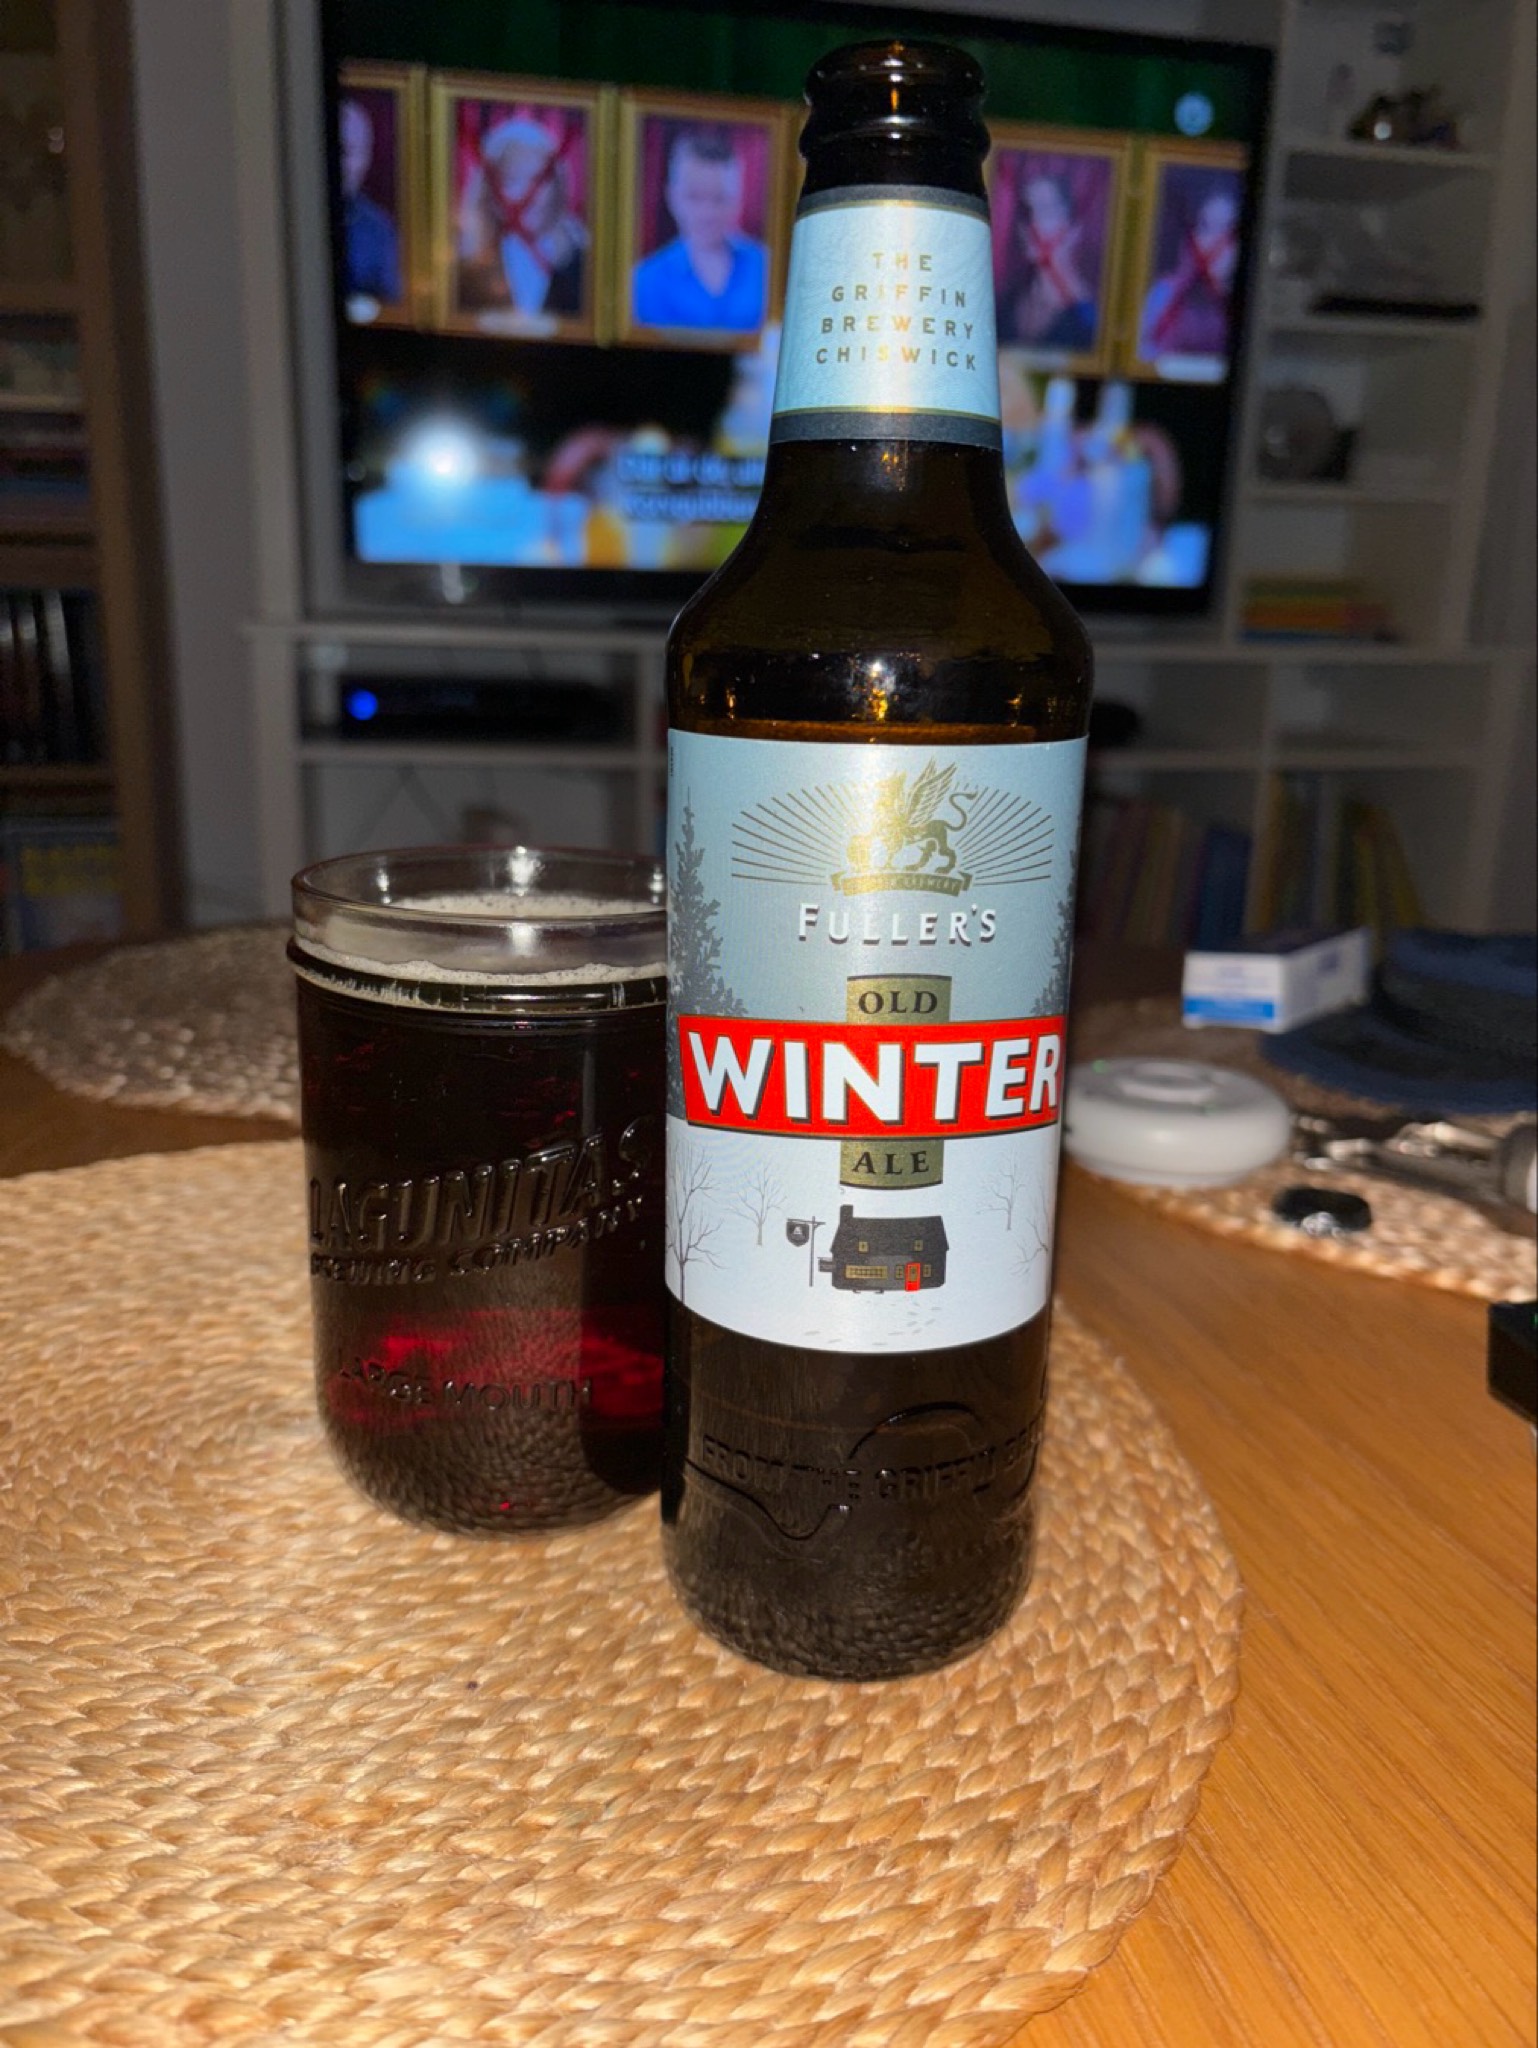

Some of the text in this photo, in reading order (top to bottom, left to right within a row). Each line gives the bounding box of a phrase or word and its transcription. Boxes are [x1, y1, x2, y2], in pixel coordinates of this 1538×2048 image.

[872, 252, 933, 272] THE
[831, 284, 967, 308] GRIFFIN
[820, 315, 974, 340] BREWERY
[815, 345, 977, 371] CHISWICK
[797, 902, 997, 946] FULLER'S
[857, 989, 939, 1015] OLD
[687, 1030, 1062, 1127] WINTER
[851, 1150, 931, 1176] ALE
